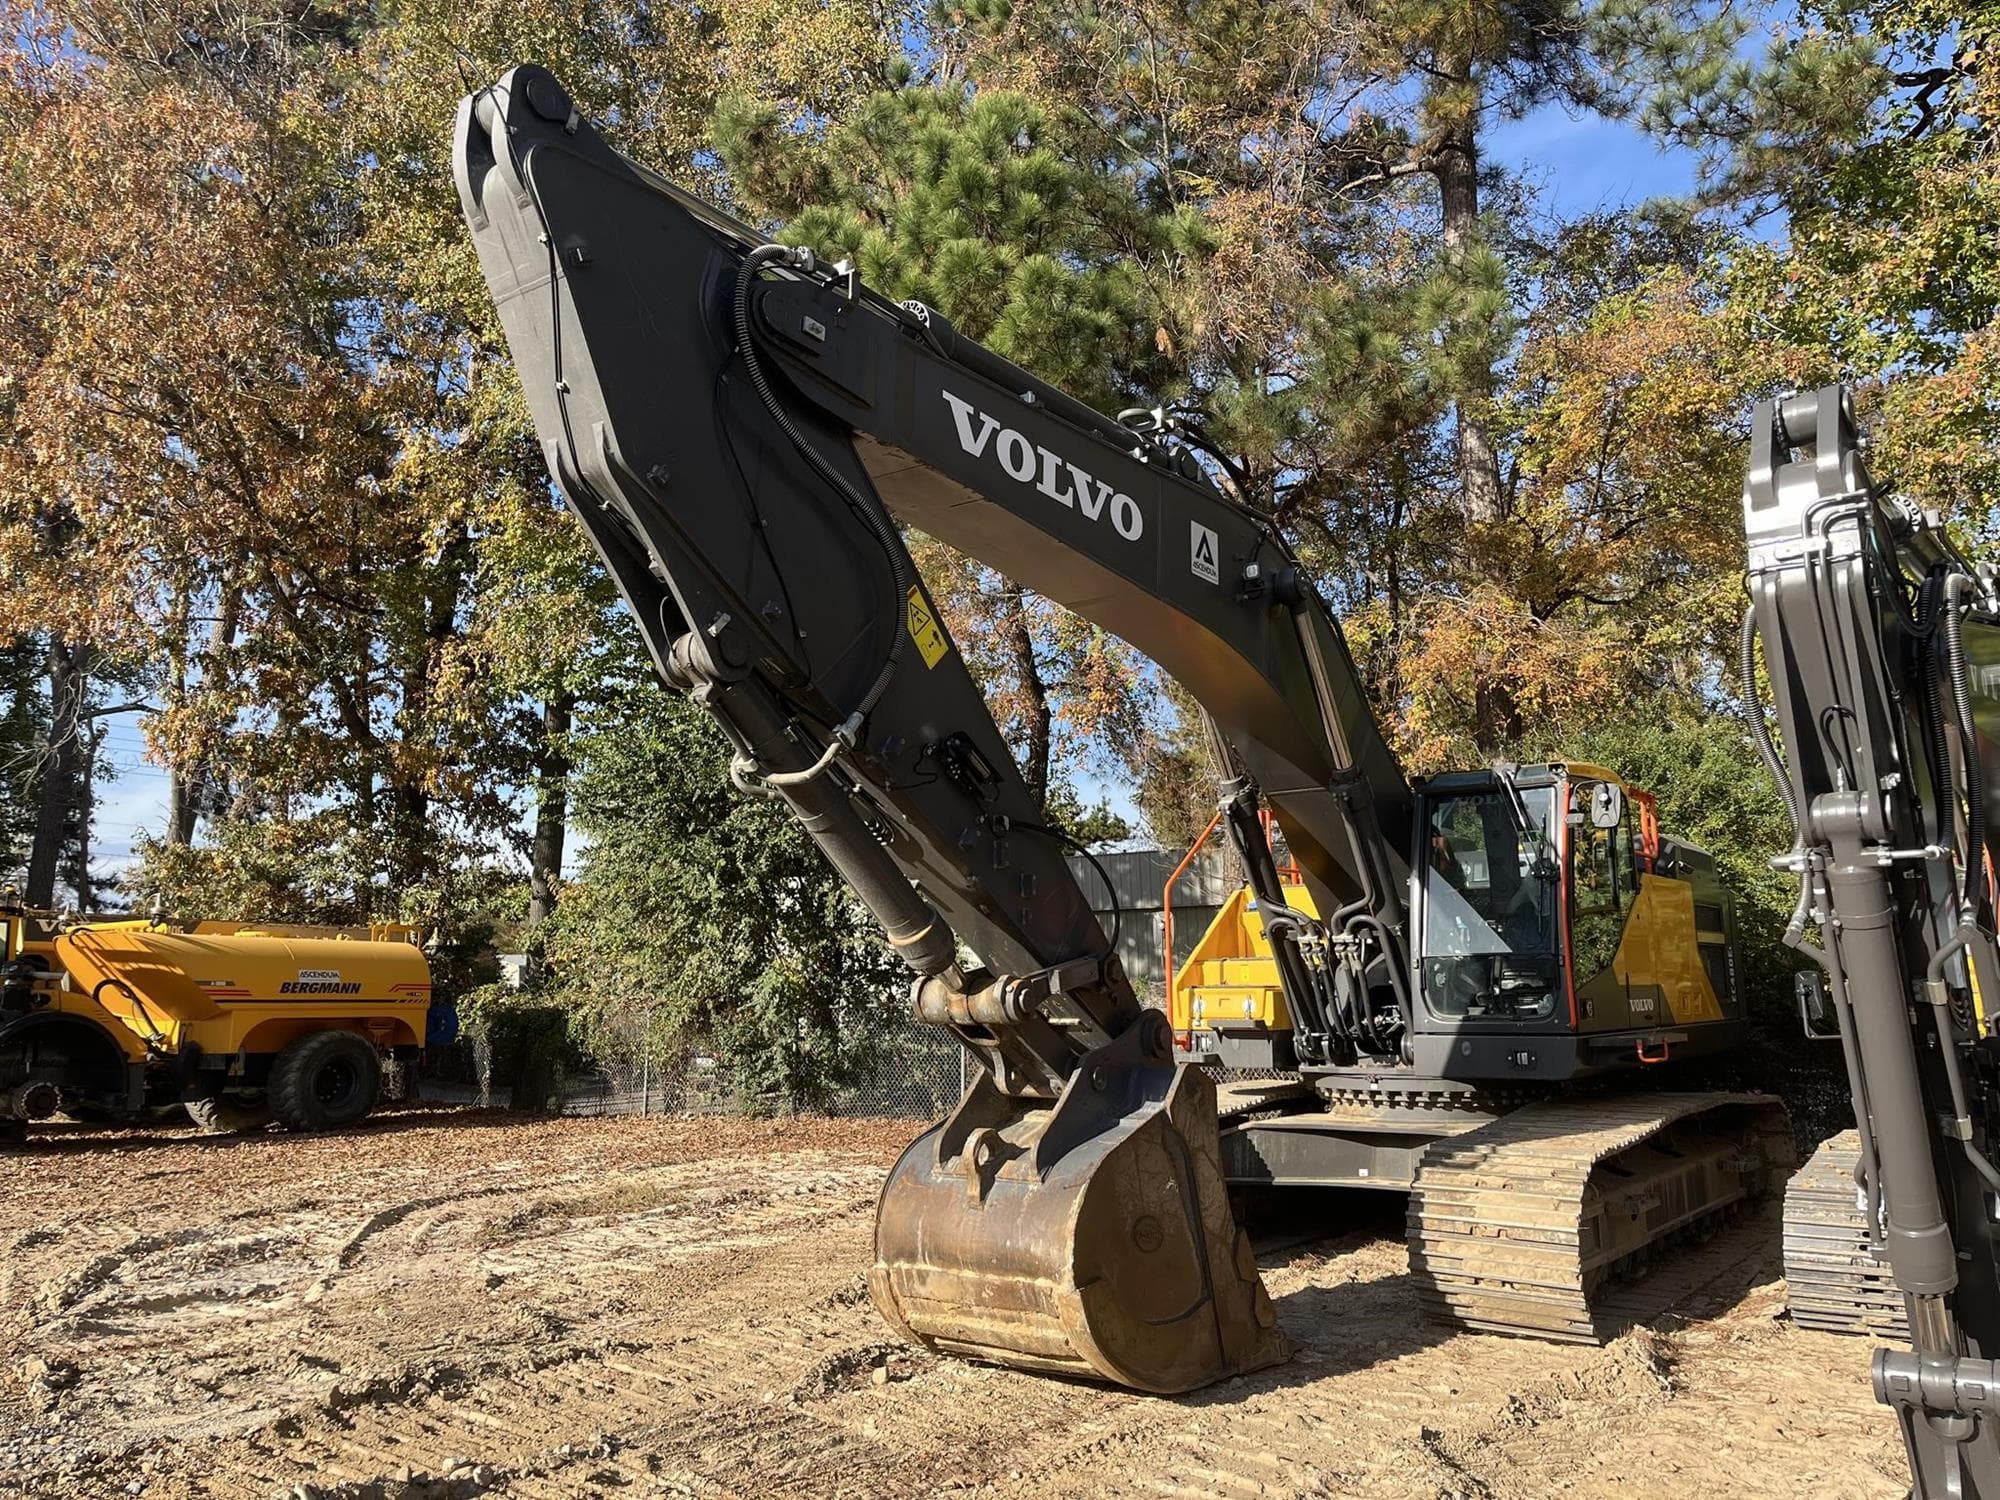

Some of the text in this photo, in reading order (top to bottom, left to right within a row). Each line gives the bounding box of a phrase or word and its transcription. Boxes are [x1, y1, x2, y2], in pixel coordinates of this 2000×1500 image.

[942, 389, 1144, 542] VOLVO
[280, 982, 362, 994] BERGMANN
[1629, 998, 1654, 1012] VOLVO
